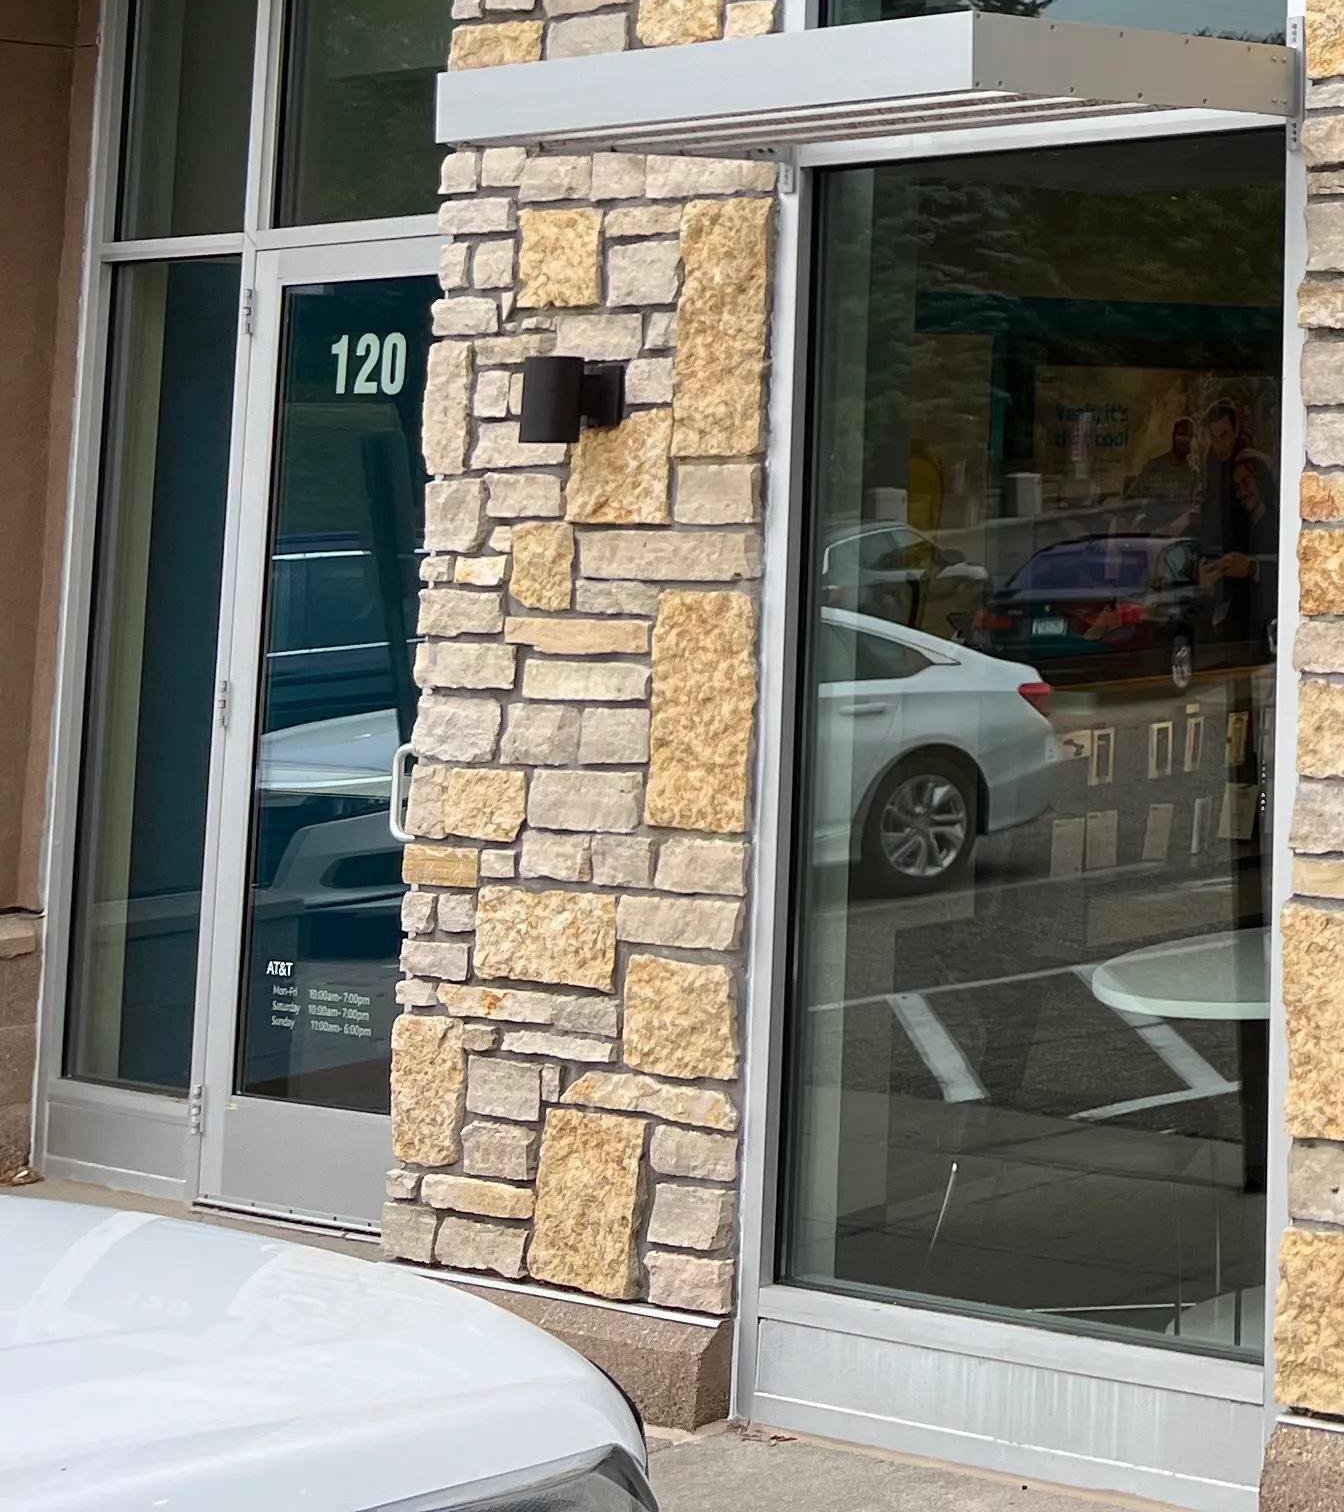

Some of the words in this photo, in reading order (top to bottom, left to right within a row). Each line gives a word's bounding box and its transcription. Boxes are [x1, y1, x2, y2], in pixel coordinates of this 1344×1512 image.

[331, 332, 407, 396] 120
[266, 961, 294, 976] AT&T
[273, 1001, 301, 1015] Saturday
[272, 1016, 296, 1030] Sunday
